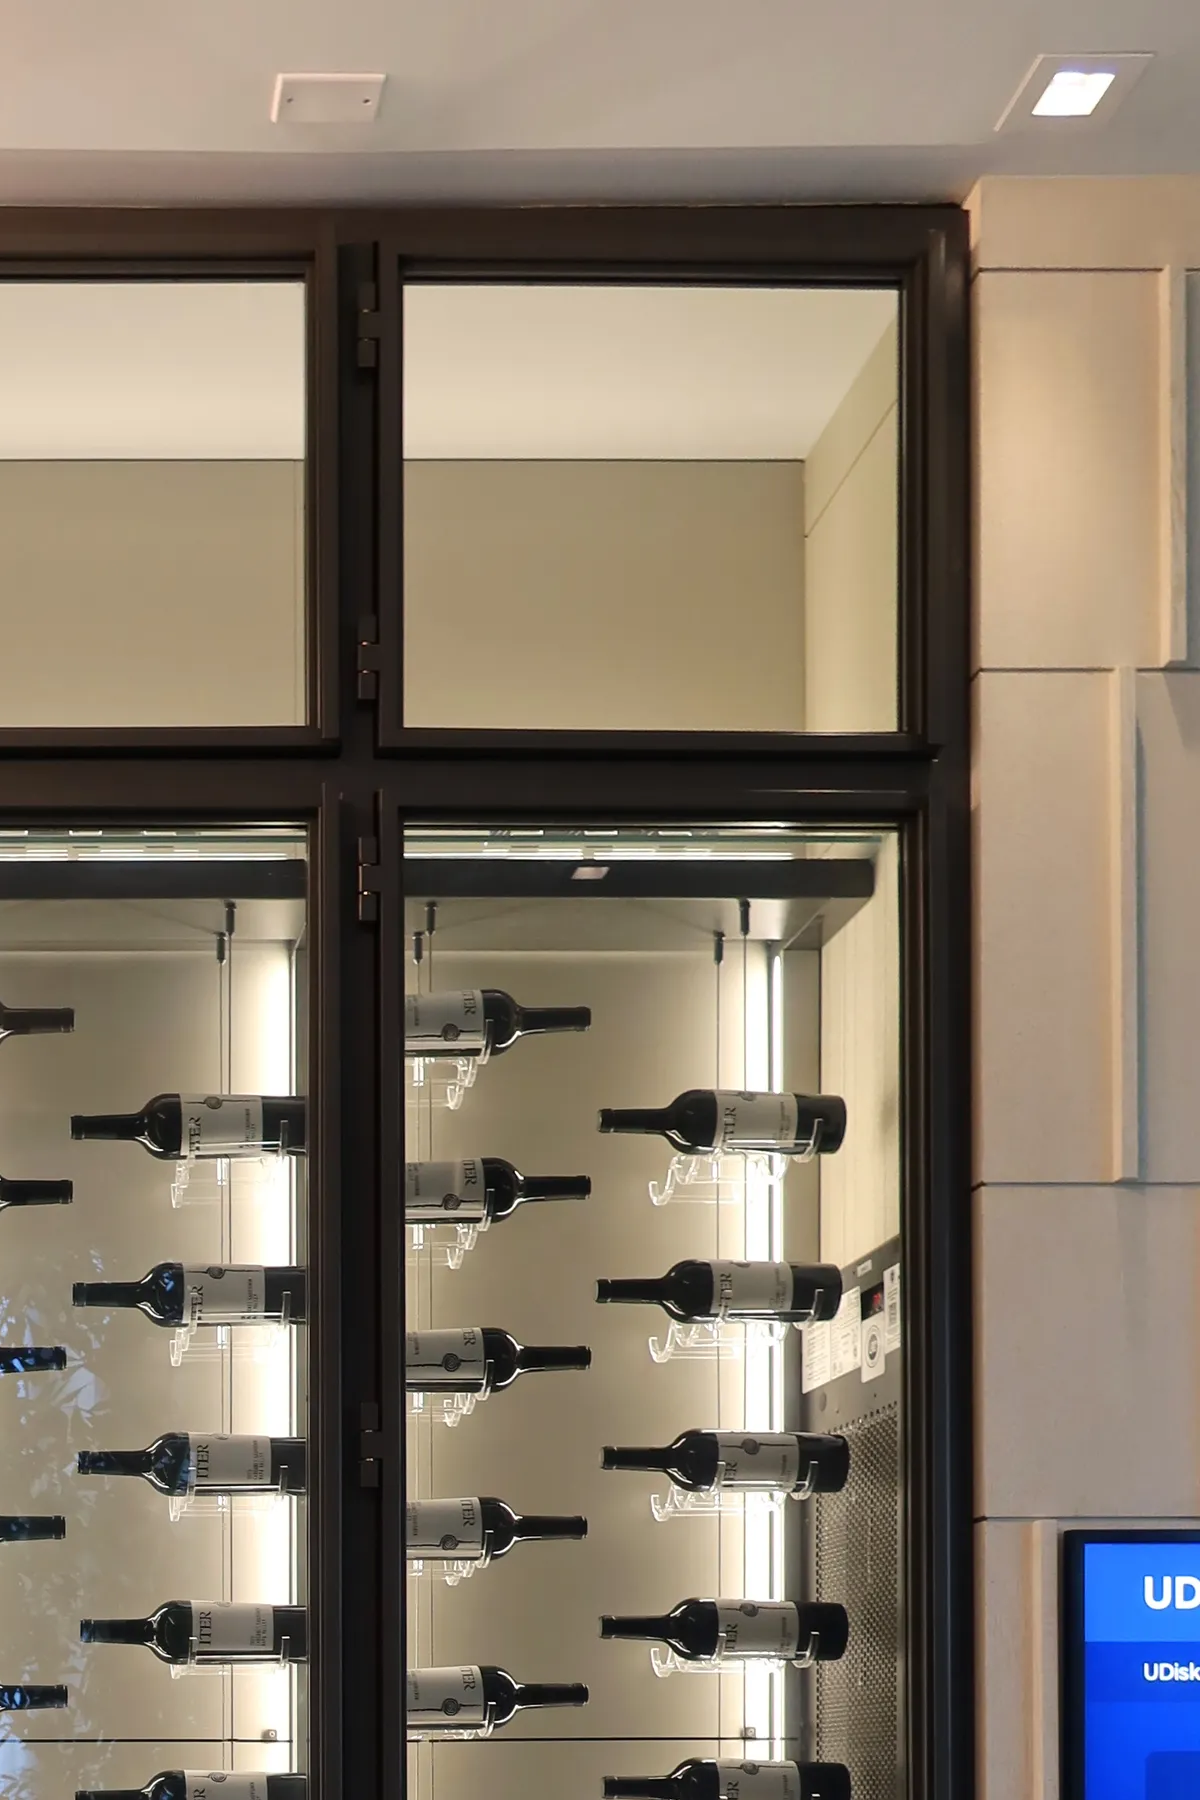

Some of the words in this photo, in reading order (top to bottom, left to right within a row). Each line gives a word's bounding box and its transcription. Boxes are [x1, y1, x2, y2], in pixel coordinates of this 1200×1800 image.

[196, 1445, 209, 1478] ITER
[1143, 1575, 1200, 1610] UD
[199, 1611, 211, 1645] ITER
[1143, 1661, 1200, 1681] UDisk
